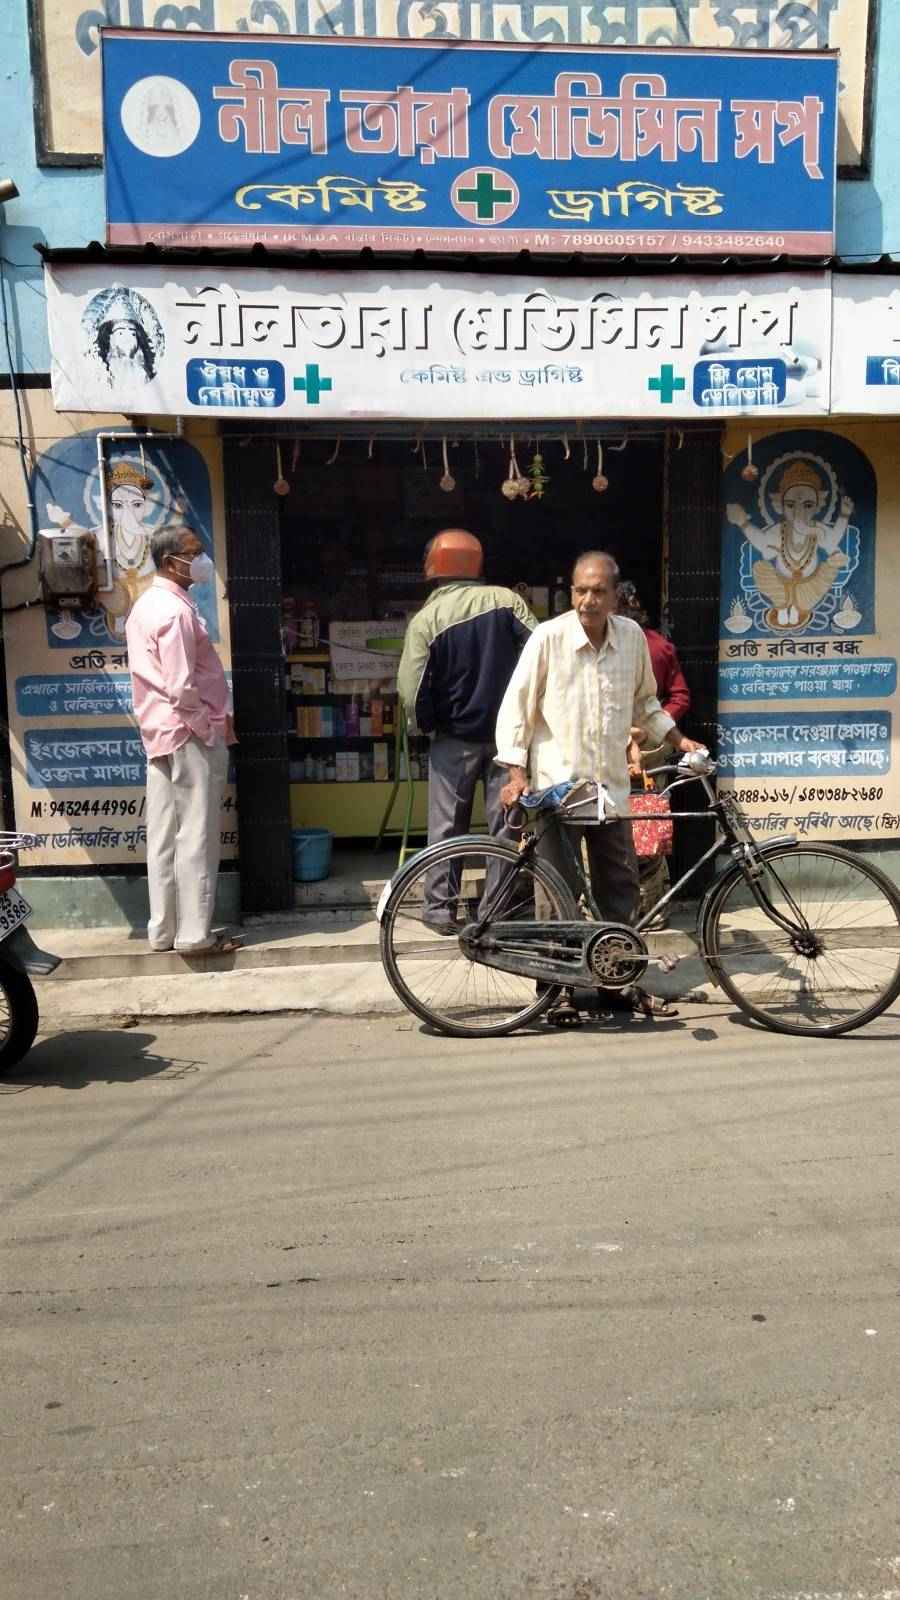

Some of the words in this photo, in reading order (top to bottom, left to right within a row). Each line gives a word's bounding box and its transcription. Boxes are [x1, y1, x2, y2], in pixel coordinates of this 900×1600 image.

[212, 59, 331, 155] নীল
[339, 86, 472, 165] তারা
[488, 72, 721, 162] মেডিসিন
[562, 234, 665, 247] 7890605157
[681, 235, 785, 248] 9433482640
[726, 639, 761, 658] প্রতি
[767, 638, 829, 658] রবিবার
[833, 639, 864, 656] বন্ধ
[69, 650, 107, 670] প্রতি
[760, 750, 805, 768] মাপার
[40, 766, 89, 783] ওজন
[92, 764, 142, 782] মাপার
[838, 814, 875, 832] আছে
